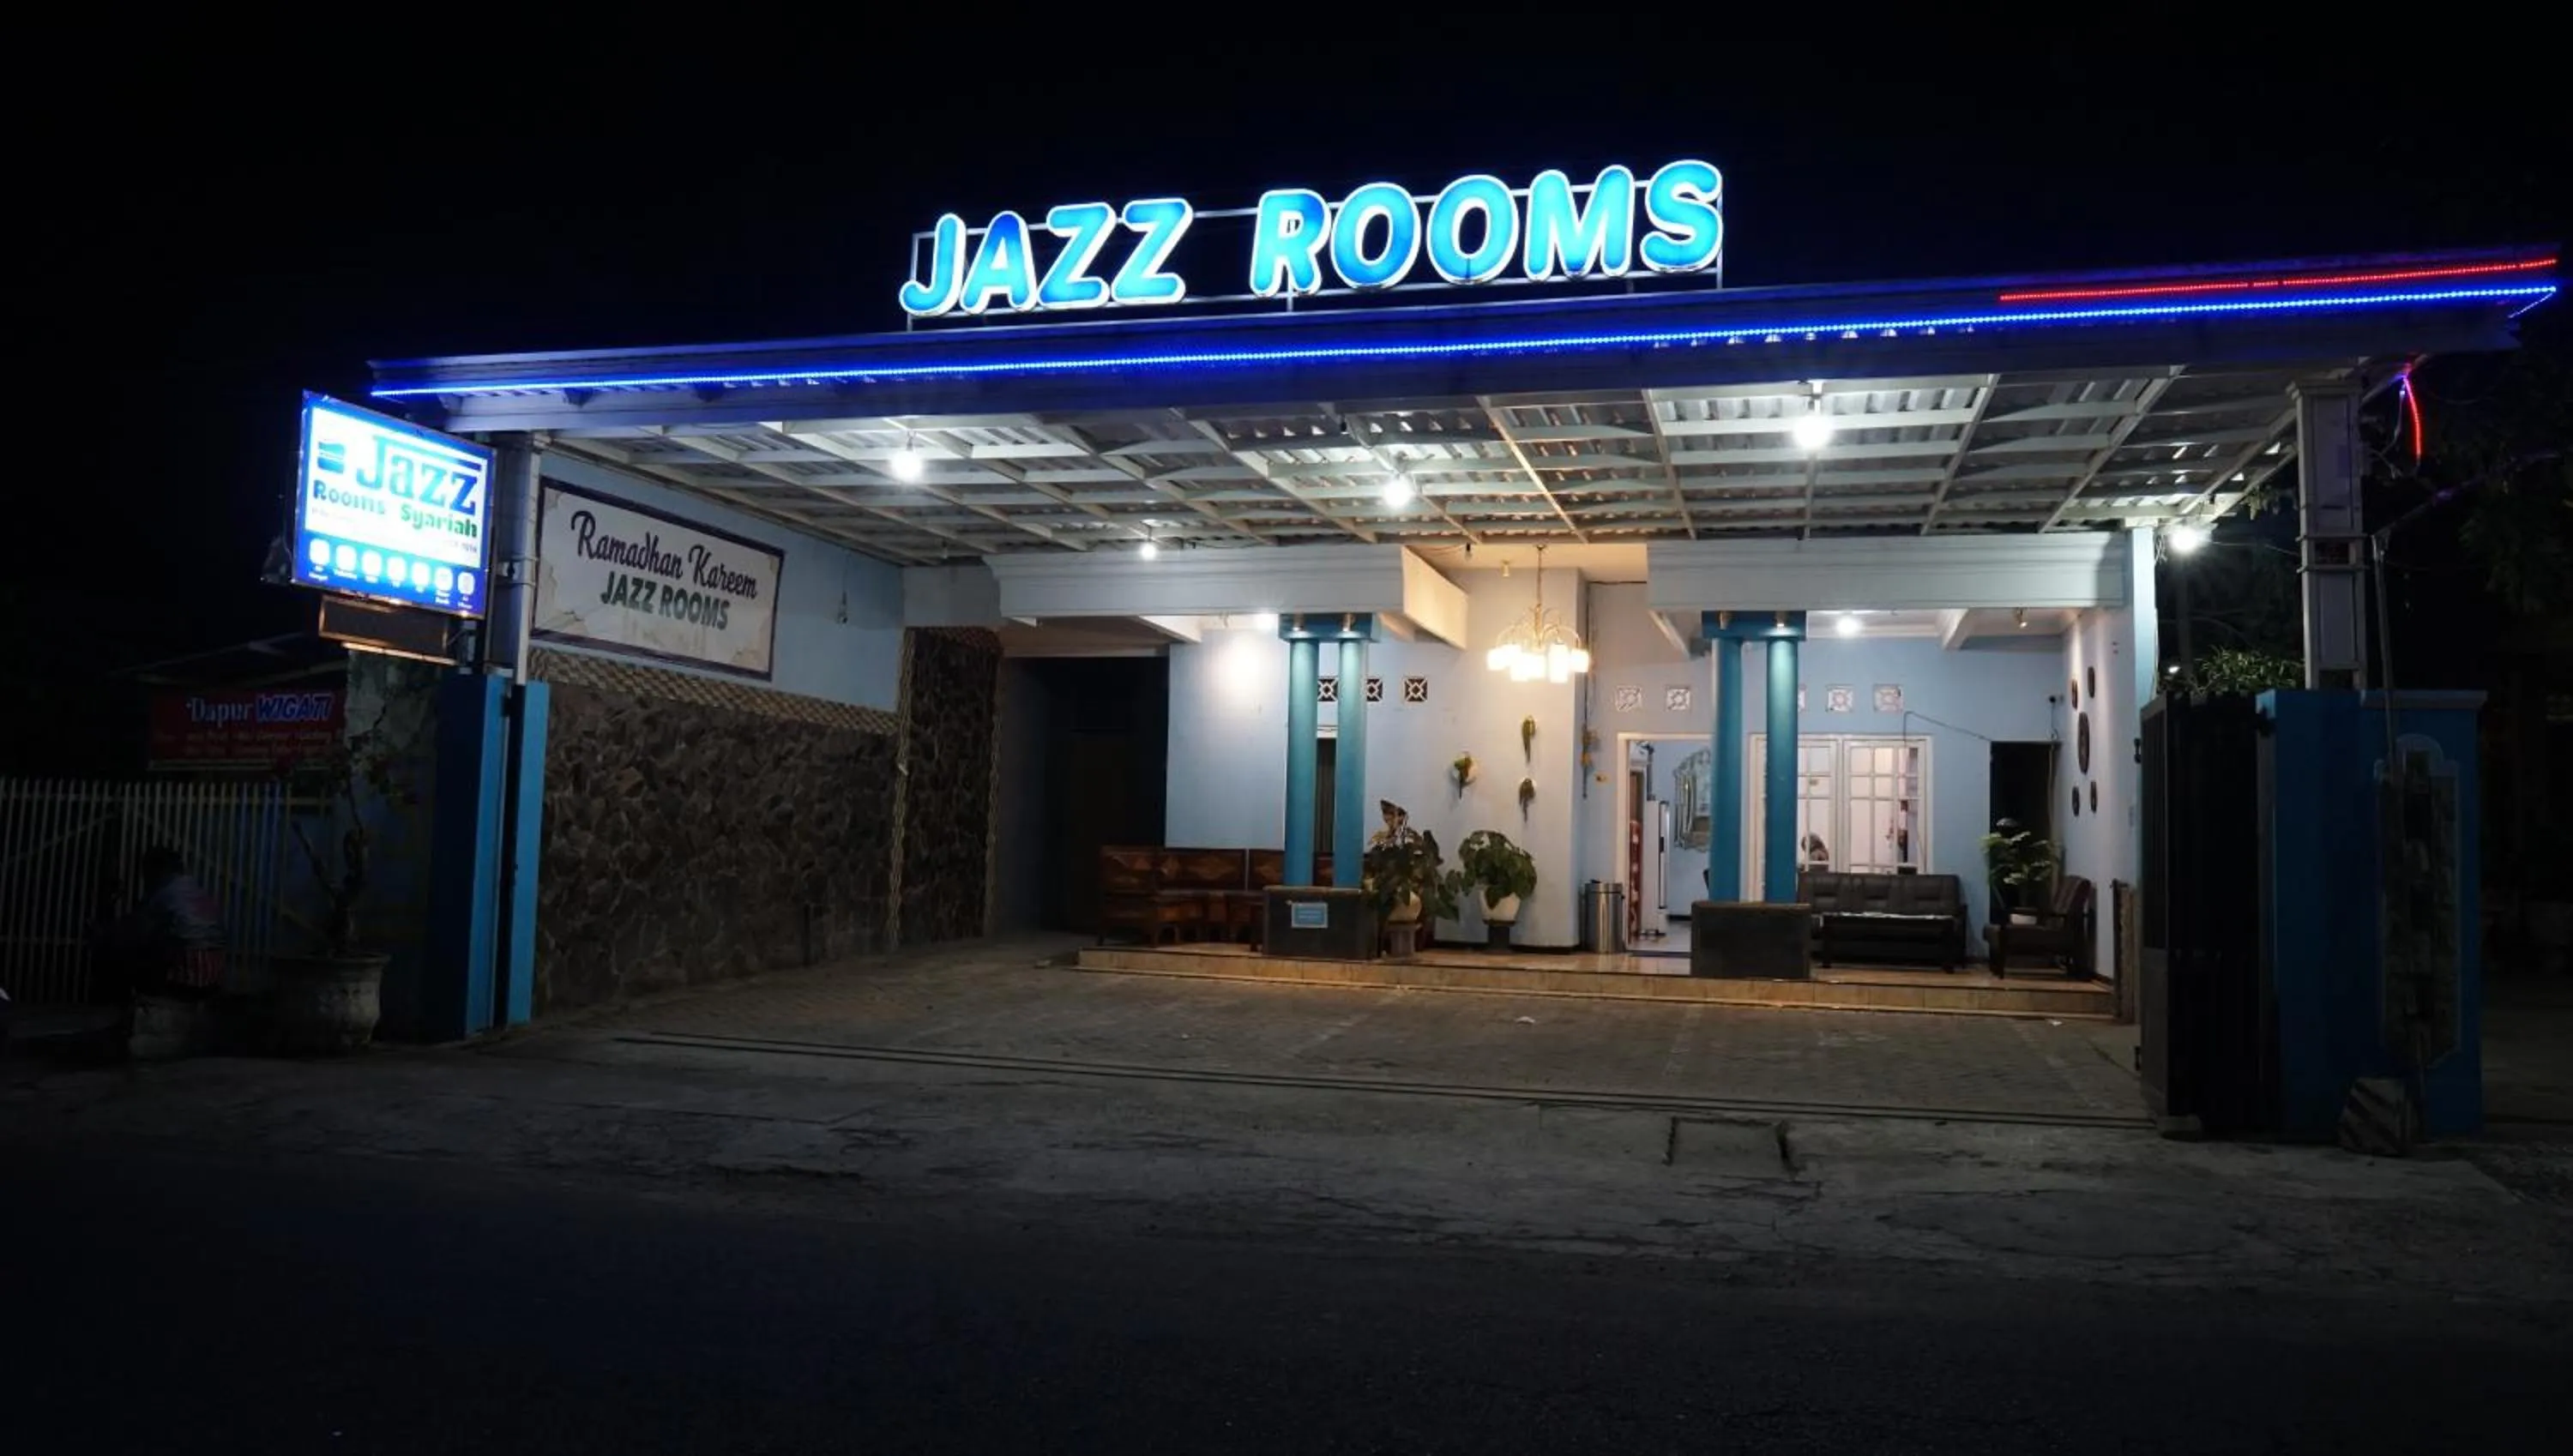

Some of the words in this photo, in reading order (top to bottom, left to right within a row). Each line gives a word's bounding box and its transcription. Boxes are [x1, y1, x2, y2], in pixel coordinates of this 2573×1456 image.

[900, 198, 1193, 316] JAZZ
[1250, 159, 1723, 298] ROOMS
[313, 479, 386, 514] Rooms
[401, 503, 478, 538] Syariah
[356, 434, 482, 516] Jazz
[570, 510, 684, 579] Ramadhan
[688, 544, 758, 599] Kareem
[600, 570, 657, 615] JAZZ
[659, 584, 731, 630] ROOMS
[190, 695, 254, 729] Dapur
[256, 692, 334, 724] WIGATI
